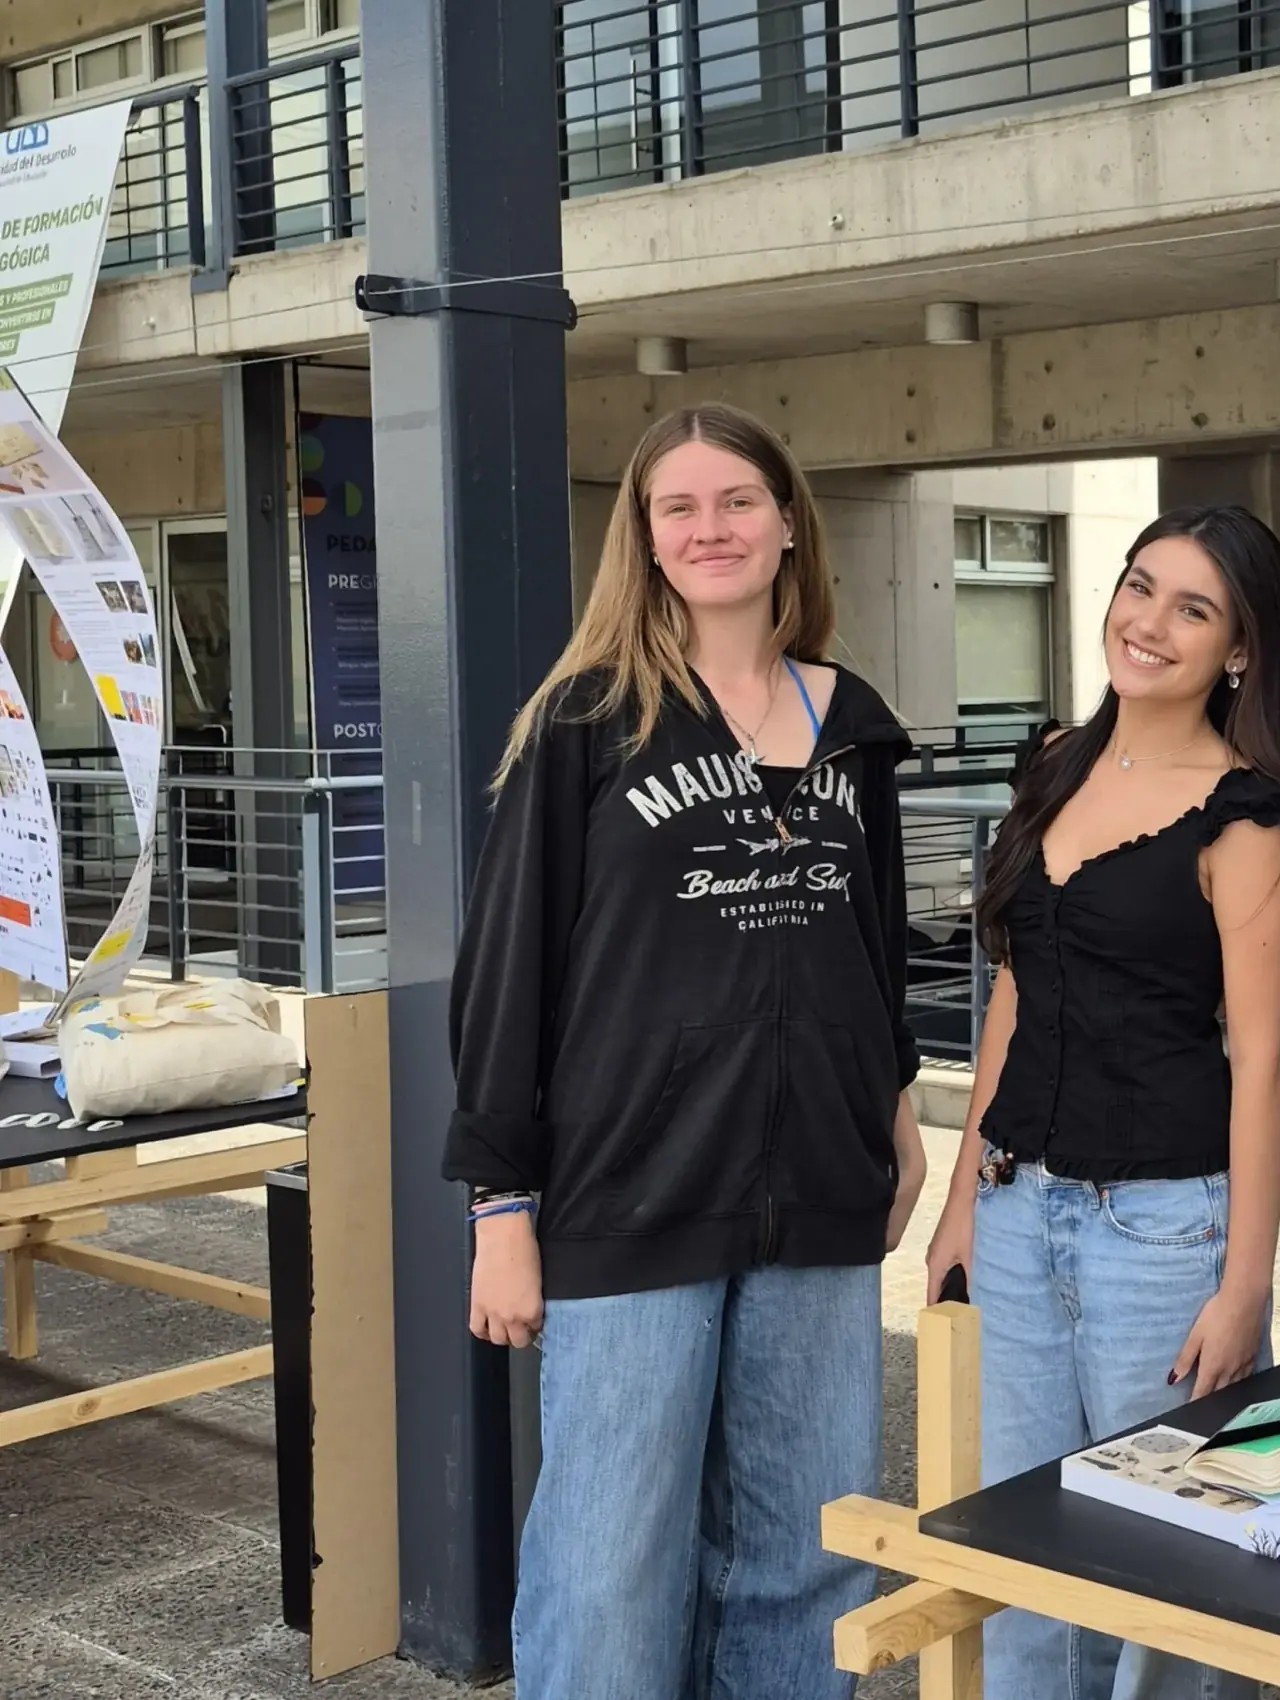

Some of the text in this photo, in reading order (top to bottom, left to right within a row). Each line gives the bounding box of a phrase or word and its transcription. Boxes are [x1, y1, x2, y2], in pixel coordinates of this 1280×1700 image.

[2, 194, 103, 240] DE FORMACIÓN
[676, 868, 762, 899] Beach
[810, 902, 824, 912] IN
